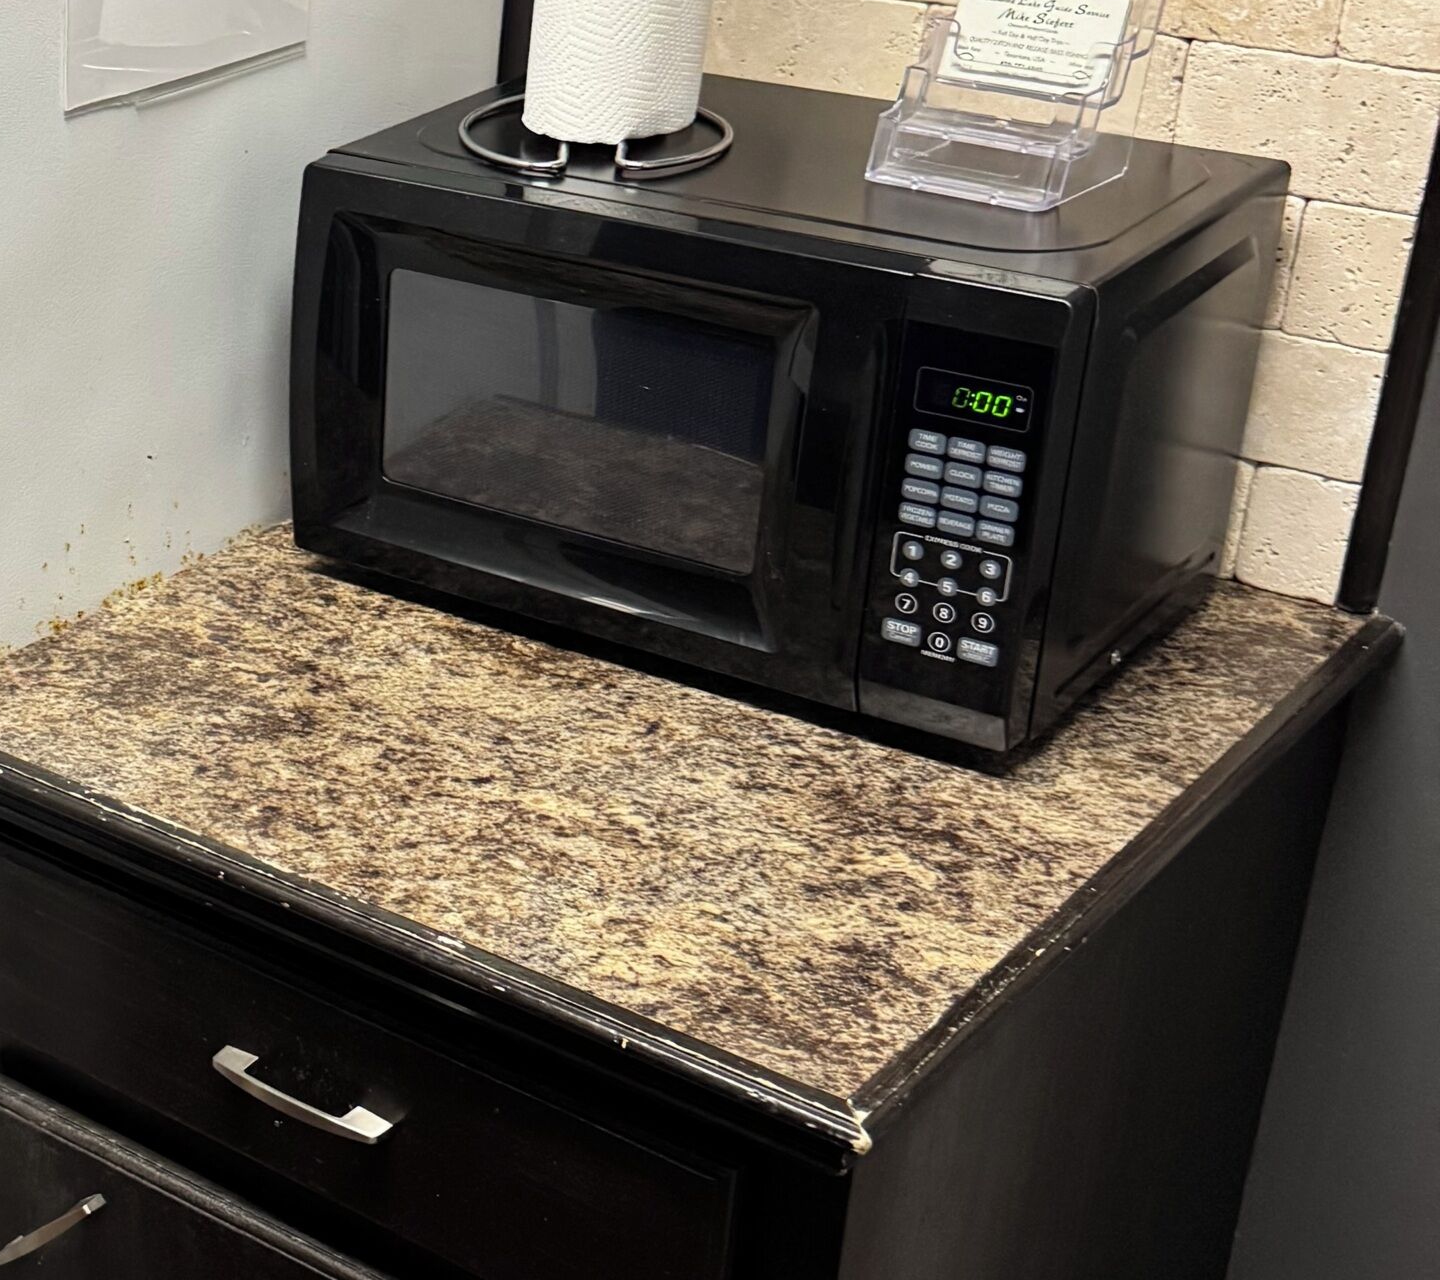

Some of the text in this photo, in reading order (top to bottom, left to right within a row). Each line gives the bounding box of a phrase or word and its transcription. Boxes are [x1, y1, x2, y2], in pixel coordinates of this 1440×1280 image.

[997, 8, 1030, 22] Mike
[1043, 0, 1072, 12] Guide
[1074, 4, 1110, 18] Service
[949, 469, 976, 480] CLOCK
[904, 484, 938, 497] POPCORN
[908, 546, 996, 575] 1 2 3
[904, 572, 992, 602] 4 5 6
[901, 598, 988, 629] 7 8 9
[887, 621, 917, 634] STOP
[935, 637, 944, 648] 0
[961, 640, 996, 655] START
